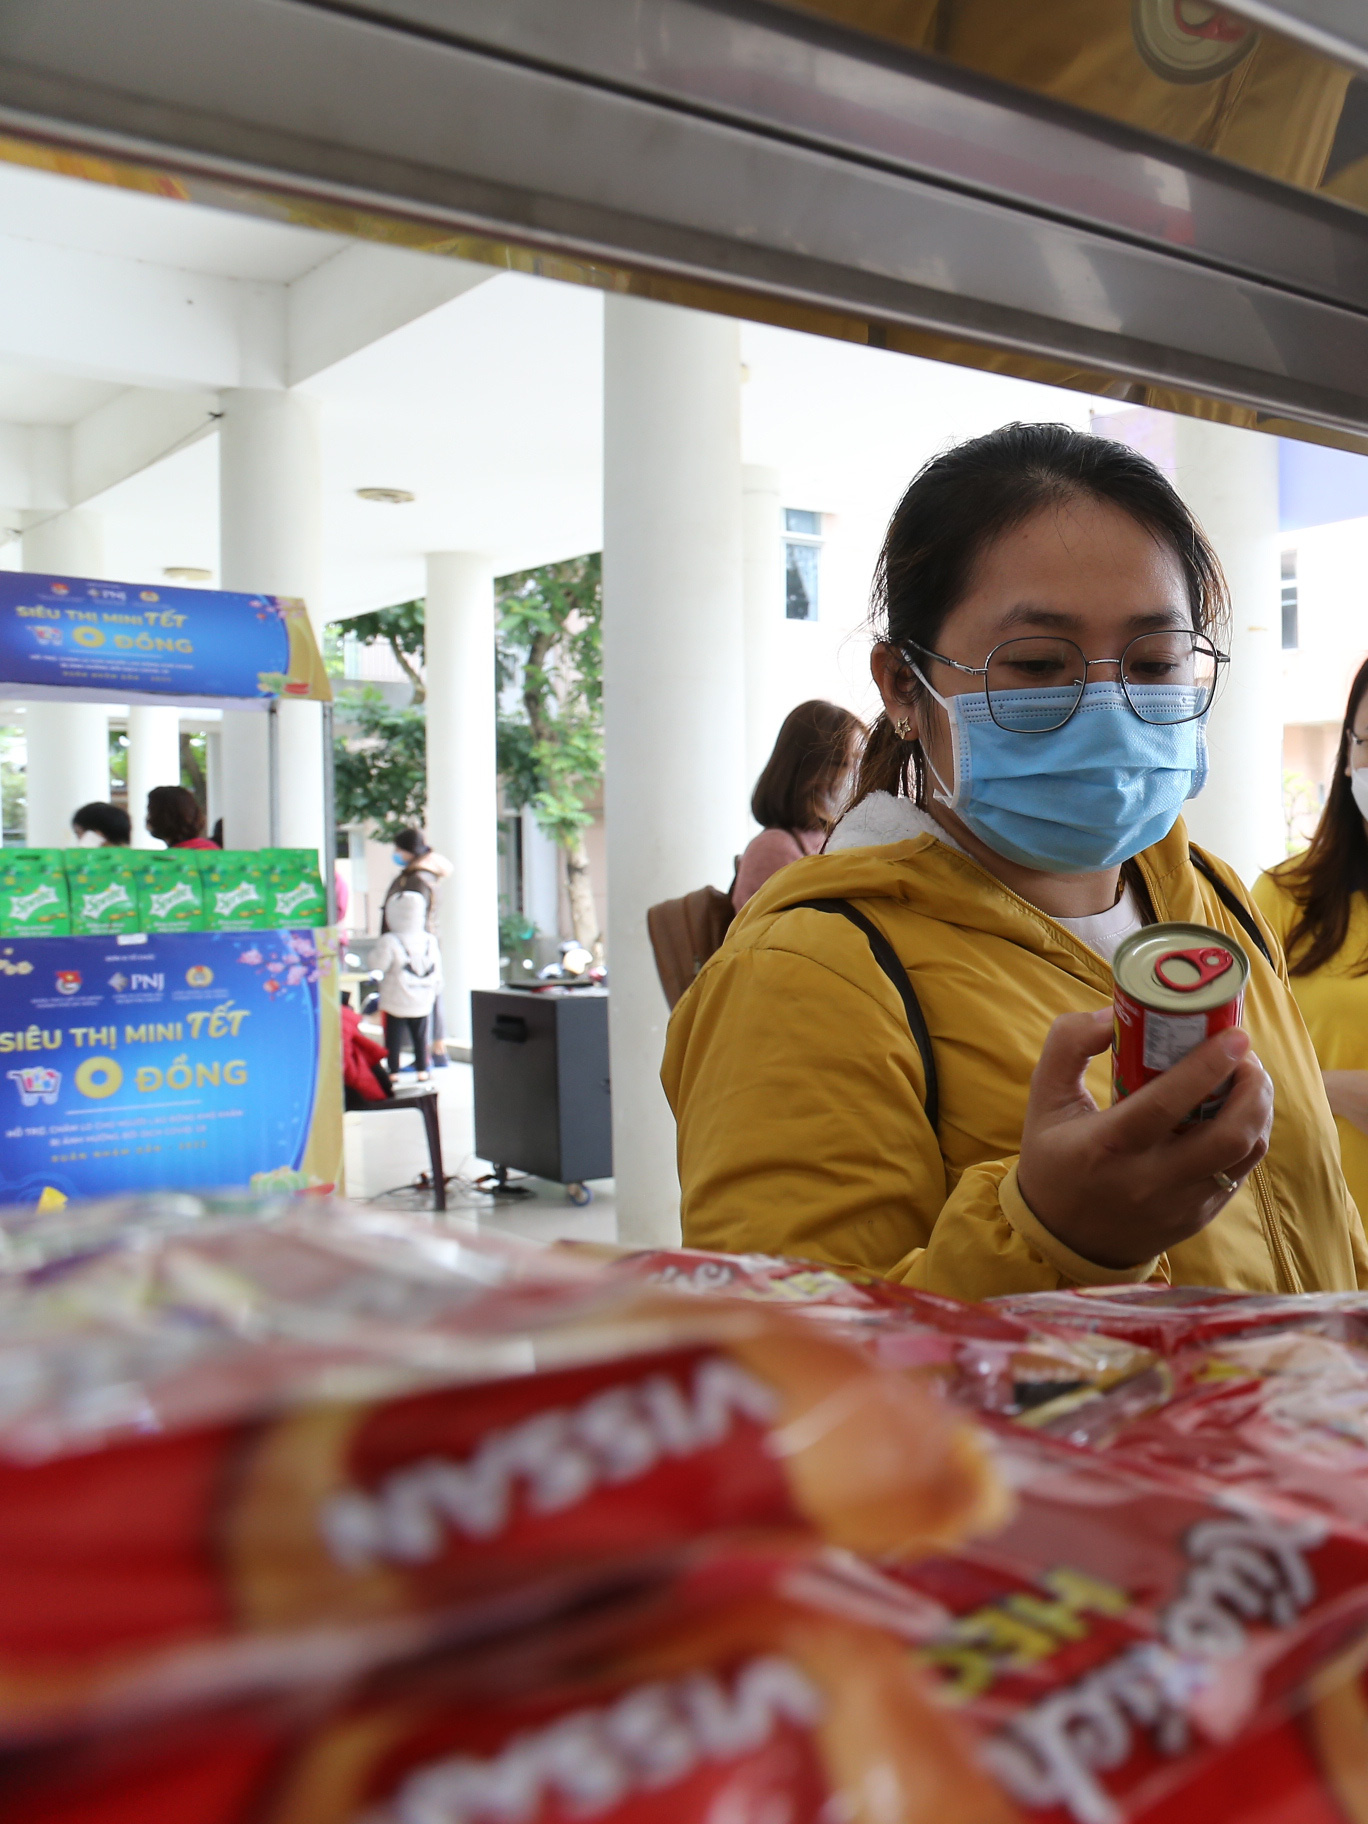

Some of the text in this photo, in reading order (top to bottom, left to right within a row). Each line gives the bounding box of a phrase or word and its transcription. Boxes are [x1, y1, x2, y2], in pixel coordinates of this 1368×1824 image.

[16, 604, 188, 628] SIÊU THỊ MINI TẾT
[131, 973, 165, 991] PNJ
[0, 1000, 251, 1053] SIÊU THỊ MINI TẾT
[318, 1356, 784, 1574] VISSAN
